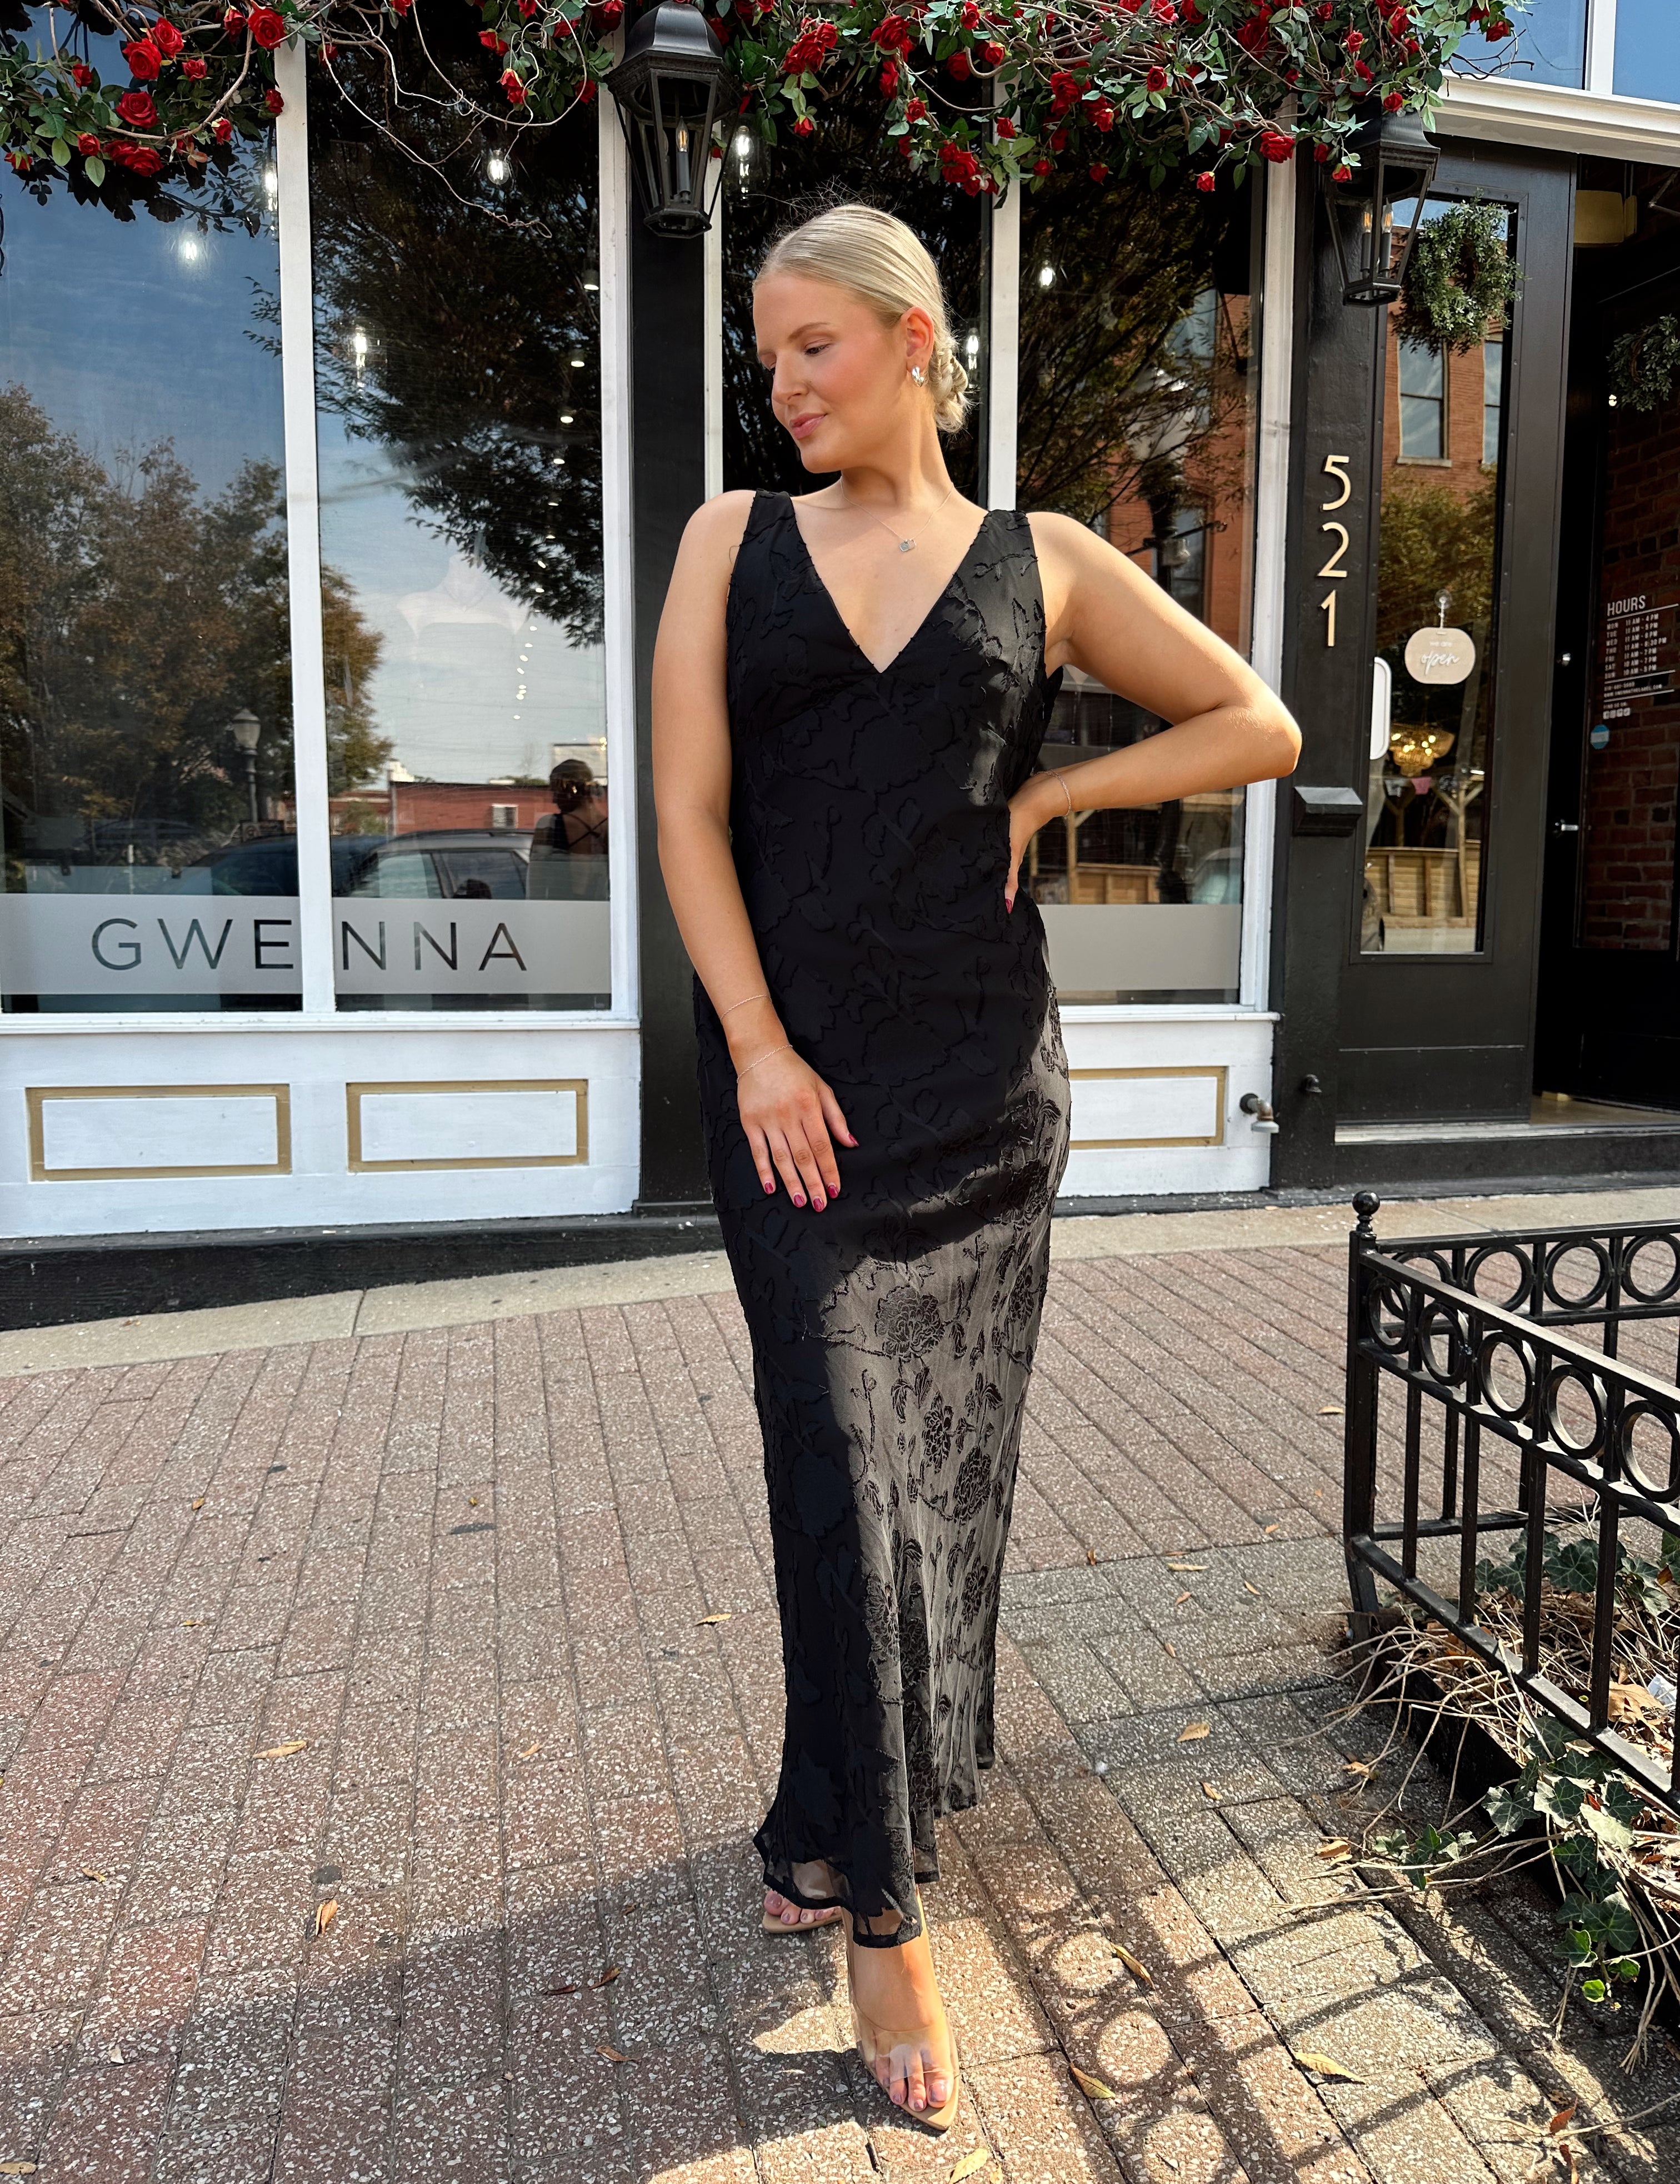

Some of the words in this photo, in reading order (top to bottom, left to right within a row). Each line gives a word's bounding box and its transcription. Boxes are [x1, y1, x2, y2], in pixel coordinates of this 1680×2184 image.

[1607, 595, 1646, 617] HOURS
[1607, 630, 1617, 638] TUE
[1421, 651, 1461, 676] open
[1605, 663, 1616, 671] SAT
[91, 918, 528, 972] GWENNA
